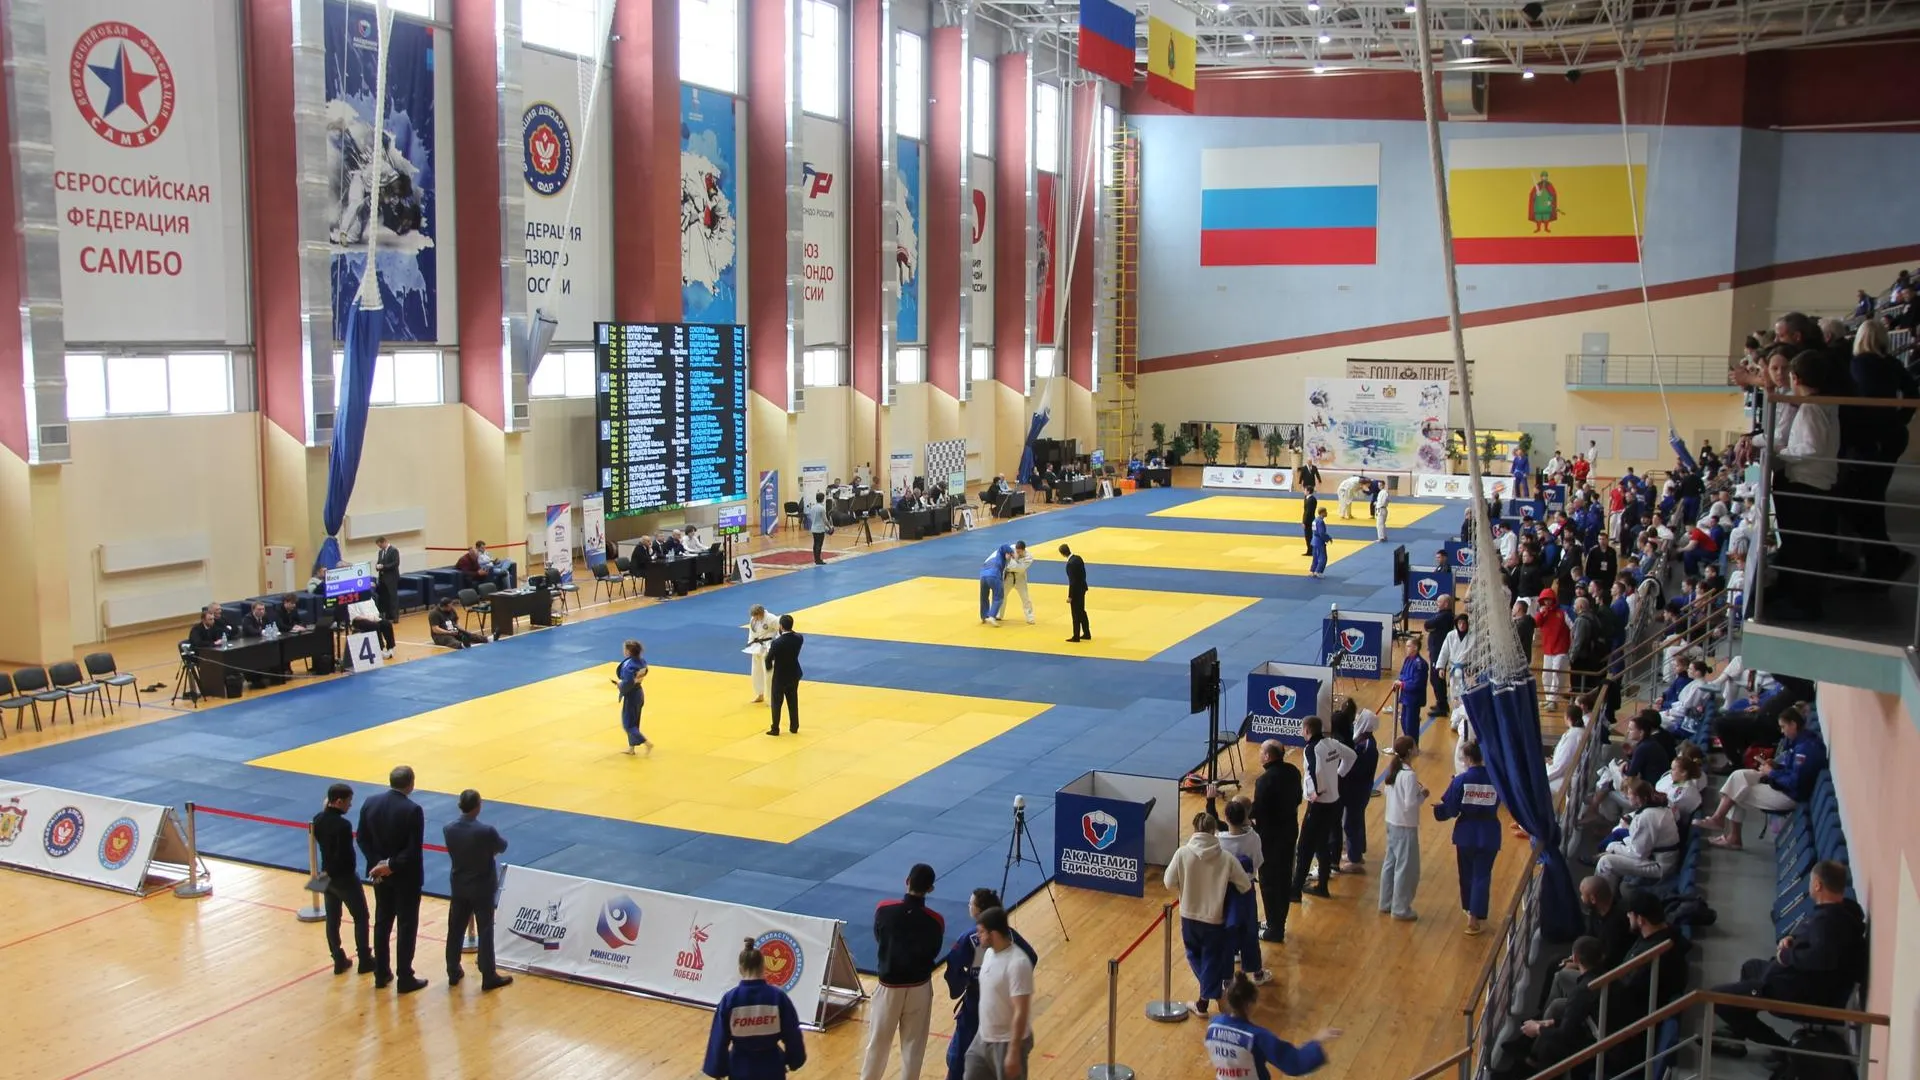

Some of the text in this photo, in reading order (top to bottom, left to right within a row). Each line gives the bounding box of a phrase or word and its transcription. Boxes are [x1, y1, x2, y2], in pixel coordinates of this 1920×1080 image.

[91, 117, 159, 146] САМБО
[538, 106, 565, 130] ДЗЮДО
[562, 132, 572, 179] РОССИИ
[54, 170, 210, 203] СЕРОССИЙСКАЯ
[537, 180, 555, 193] ФДР
[67, 207, 189, 236] ФЕДЕРАЦИЯ
[804, 243, 819, 259] ЮЗ
[80, 246, 182, 276] САМБО
[964, 512, 973, 528] 2
[726, 525, 740, 534] 0:49
[357, 569, 363, 577] 0
[742, 558, 752, 579] 3
[357, 579, 363, 588] 0
[359, 636, 376, 664] 4
[1253, 714, 1303, 728] АКАДЕМИ
[1252, 723, 1303, 736] ЕДИНОБОРС
[1464, 790, 1496, 799] FONBET
[1061, 848, 1138, 872] АКАДЕМИЯ
[1061, 861, 1138, 882] ЕДИНОБОРСТВ
[516, 906, 541, 921] ЛИГА
[513, 919, 567, 940] ПАТРИОТОВ
[590, 948, 631, 964] МИНСПОРТ
[676, 950, 693, 969] 80
[733, 1015, 777, 1028] FONBET
[1215, 1045, 1237, 1059] RUS
[1216, 1066, 1251, 1078] ONBET
